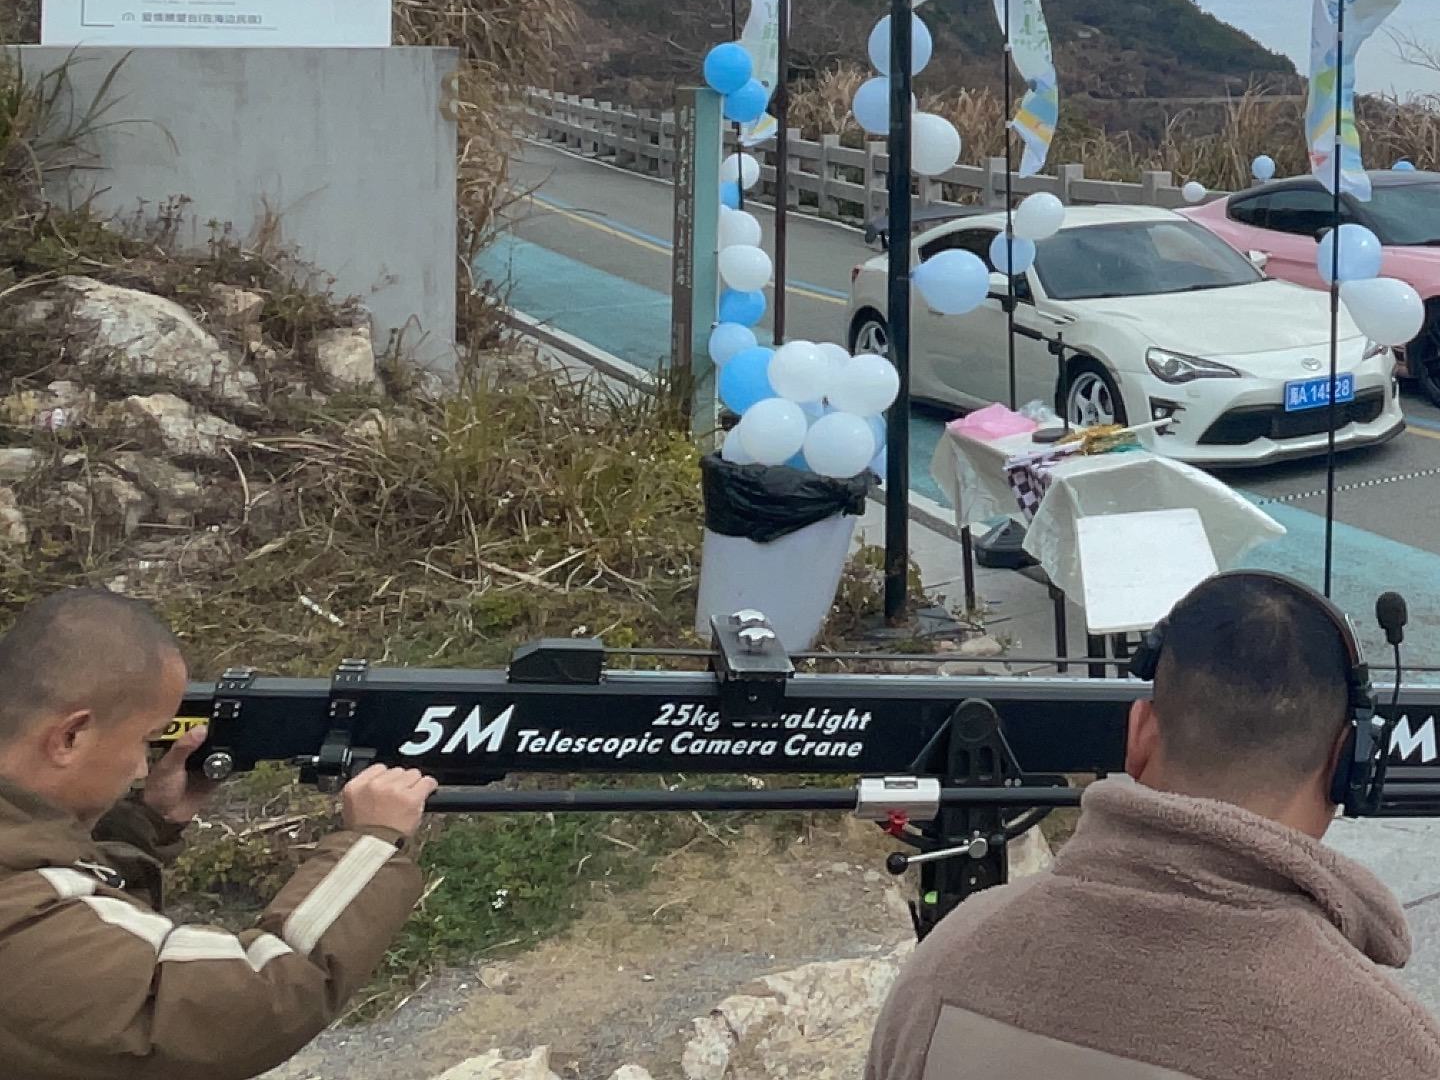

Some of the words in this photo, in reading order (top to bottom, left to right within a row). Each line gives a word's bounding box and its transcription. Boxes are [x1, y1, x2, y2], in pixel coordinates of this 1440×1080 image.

[398, 704, 515, 756] 5M
[516, 729, 664, 759] Telescopic
[670, 731, 778, 756] Camera
[784, 733, 863, 757] Crane
[651, 703, 720, 732] 25kg
[732, 707, 872, 735] aLight
